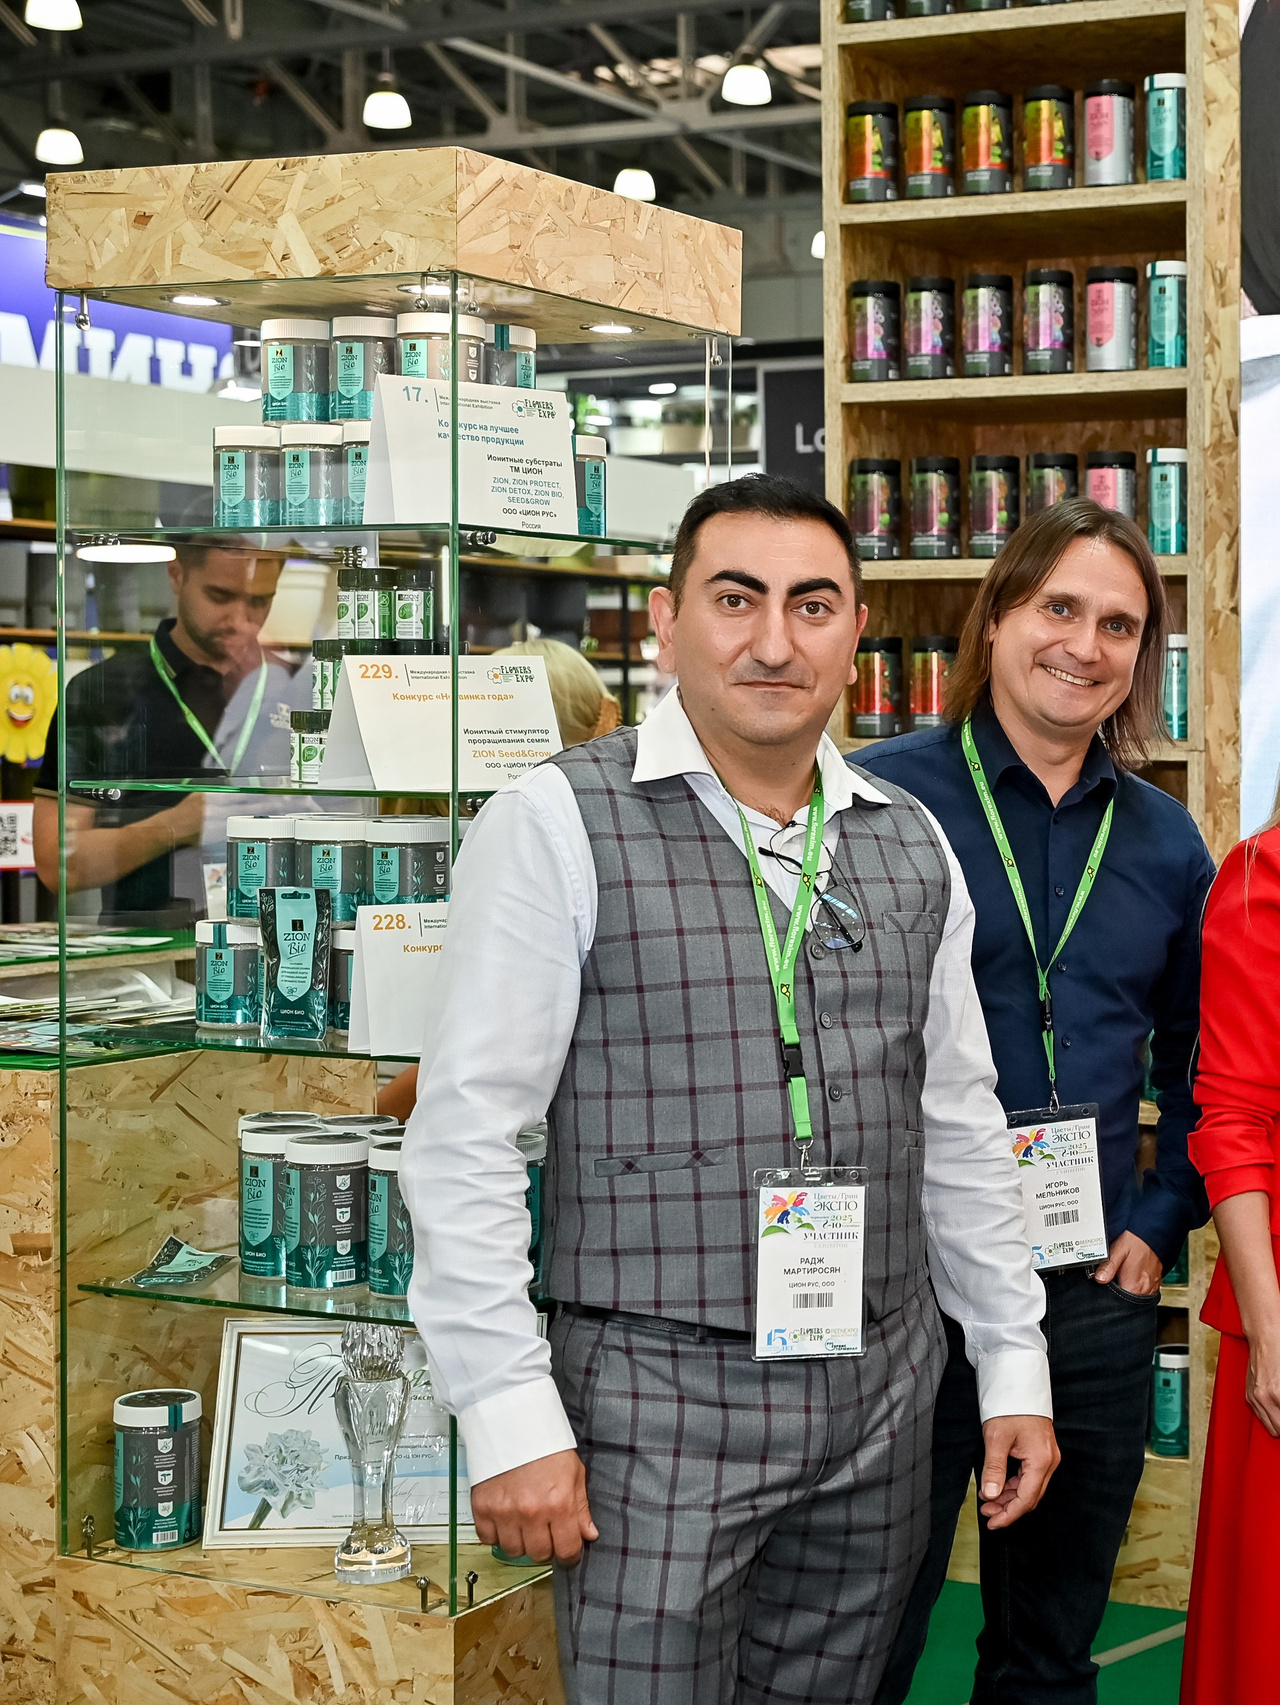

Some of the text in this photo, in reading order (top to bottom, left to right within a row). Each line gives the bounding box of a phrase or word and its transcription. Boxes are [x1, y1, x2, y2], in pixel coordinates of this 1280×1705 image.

[402, 385, 429, 403] 17.
[438, 419, 478, 431] Кокурс
[490, 426, 520, 435] лучшее
[481, 436, 524, 446] продукции
[486, 454, 563, 468] Ионитные субстраты
[509, 466, 543, 476] ТМ ЦИОН
[492, 476, 562, 489] ZION, ZION PROTECT,
[508, 487, 533, 496] DETOX,
[534, 489, 550, 497] ZION
[552, 490, 564, 499] BIO,
[507, 496, 550, 506] SEED&GROW
[518, 508, 540, 518] «ЦИОН
[542, 510, 557, 518] РУС»
[522, 521, 542, 530] Россия
[358, 664, 399, 679] 229.
[392, 692, 514, 702] Конкурс «Нвинка года»
[463, 728, 550, 736] Ионитный стимулятор
[468, 738, 526, 746] проращивания
[472, 750, 552, 758] ZION Seed&Grow
[979, 780, 1004, 841] www.florexim.eu
[372, 914, 412, 930] 228.
[284, 932, 310, 942] ZION
[782, 904, 804, 970] www.florexim.eu
[287, 942, 307, 956] Bio
[1052, 1130, 1091, 1144] ЭКСПО
[1046, 1156, 1094, 1170] УЧАСТНИК
[244, 1178, 266, 1188] ZION
[1045, 1180, 1068, 1190] ИГОРЬ
[247, 1188, 262, 1200] Bio
[814, 1192, 858, 1201] Цветы/Грин
[1036, 1186, 1080, 1200] МЕЛЬНИКОВ
[814, 1200, 858, 1212] ЭКСПО
[830, 1214, 852, 1223] 2025
[804, 1232, 859, 1241] УЧАСТНИК
[800, 1257, 824, 1266] РАДЖ
[784, 1266, 841, 1276] МАРТИРОСЯН
